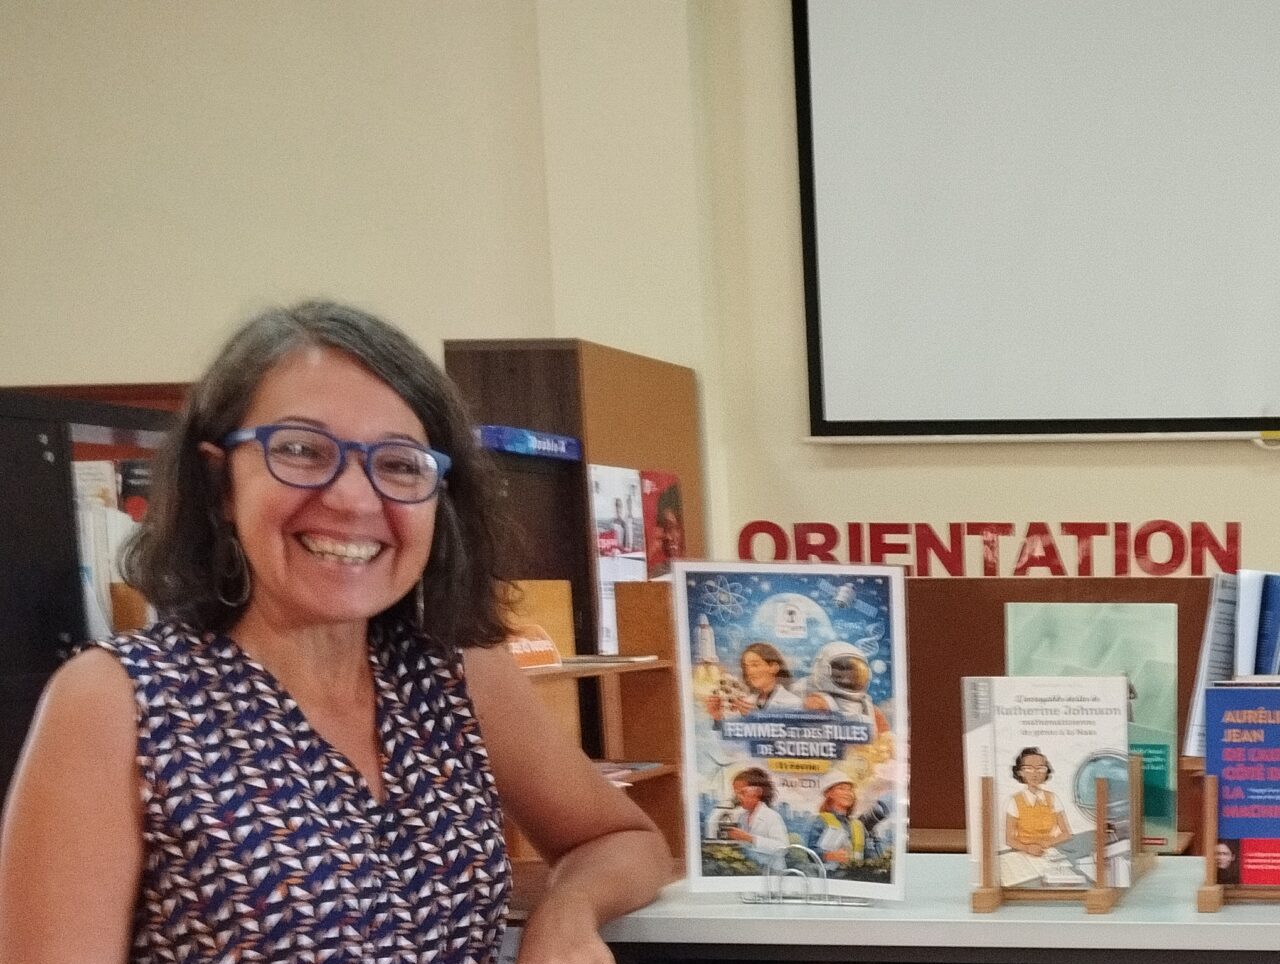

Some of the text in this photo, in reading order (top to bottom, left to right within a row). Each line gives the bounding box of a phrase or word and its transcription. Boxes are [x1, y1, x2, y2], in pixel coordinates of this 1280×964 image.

[737, 519, 1242, 577] ORIENTATION
[1063, 704, 1122, 716] Johnson
[724, 721, 787, 738] FEMMES
[803, 726, 823, 739] DES
[824, 725, 869, 741] FILLES
[1222, 729, 1265, 742] JEAN
[775, 741, 838, 758] SCIENCE
